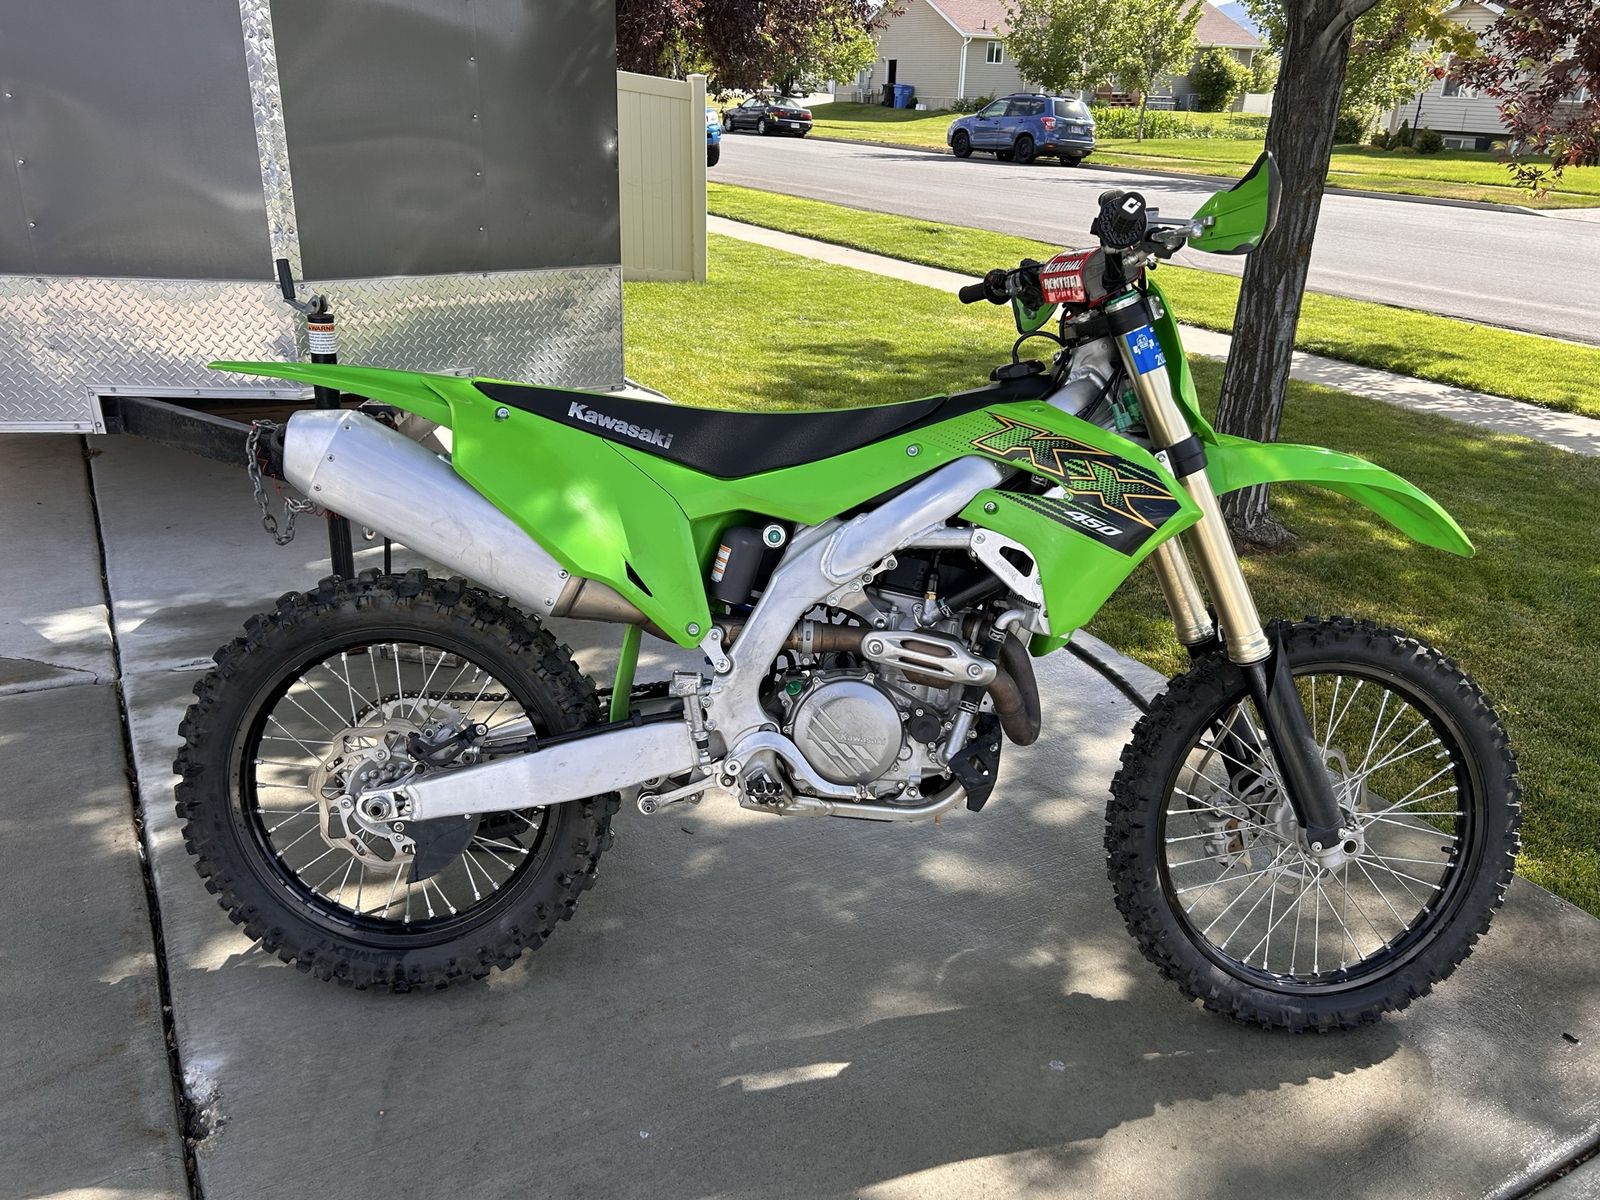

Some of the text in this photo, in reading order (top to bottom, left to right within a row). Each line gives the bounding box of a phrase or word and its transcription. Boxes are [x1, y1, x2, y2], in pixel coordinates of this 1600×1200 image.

[1042, 274, 1082, 290] RENTHAL
[567, 401, 674, 450] Kawasaki
[1063, 510, 1124, 537] 450
